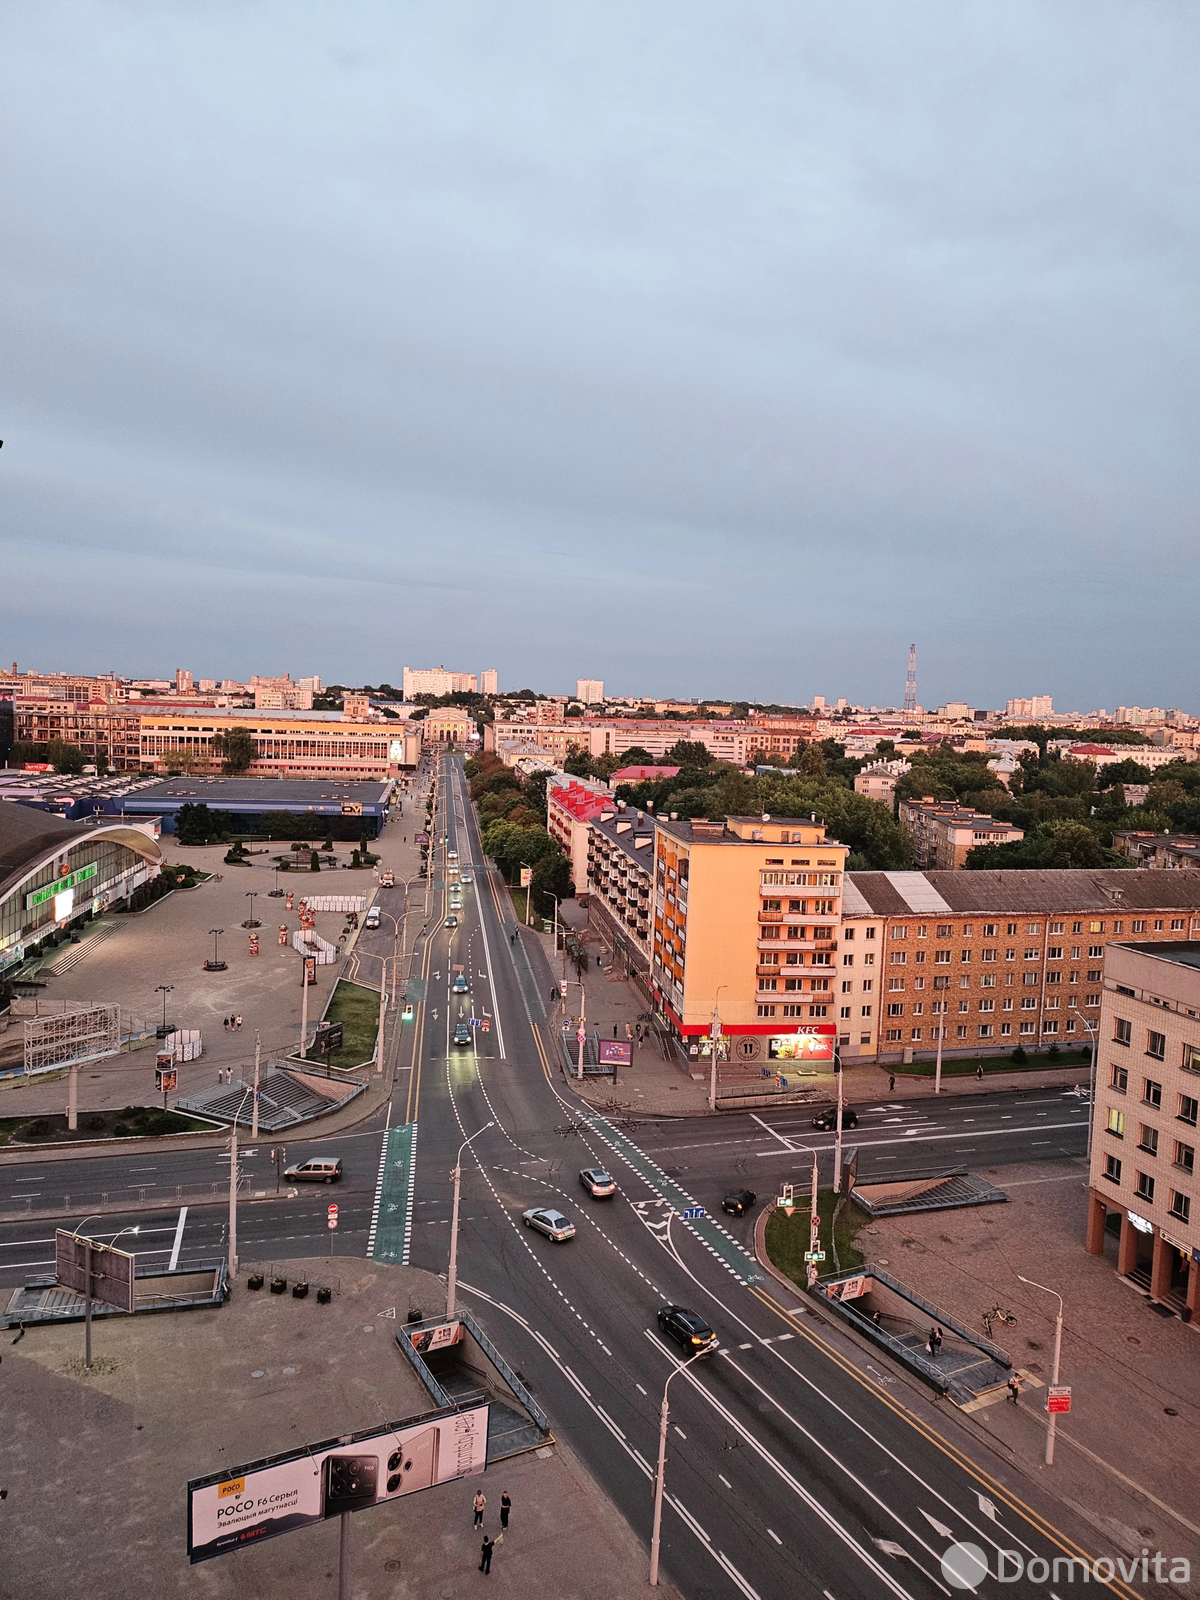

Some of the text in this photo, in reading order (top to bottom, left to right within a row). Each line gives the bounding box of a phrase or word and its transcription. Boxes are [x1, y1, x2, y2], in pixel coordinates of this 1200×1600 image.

[797, 1026, 819, 1035] KFC
[743, 1043, 753, 1054] 11
[222, 1483, 241, 1494] POCO
[217, 1489, 298, 1519] POCO F6 Серыя
[217, 1498, 298, 1529] Эвалюцыя магутнасці
[246, 1526, 267, 1539] МТС
